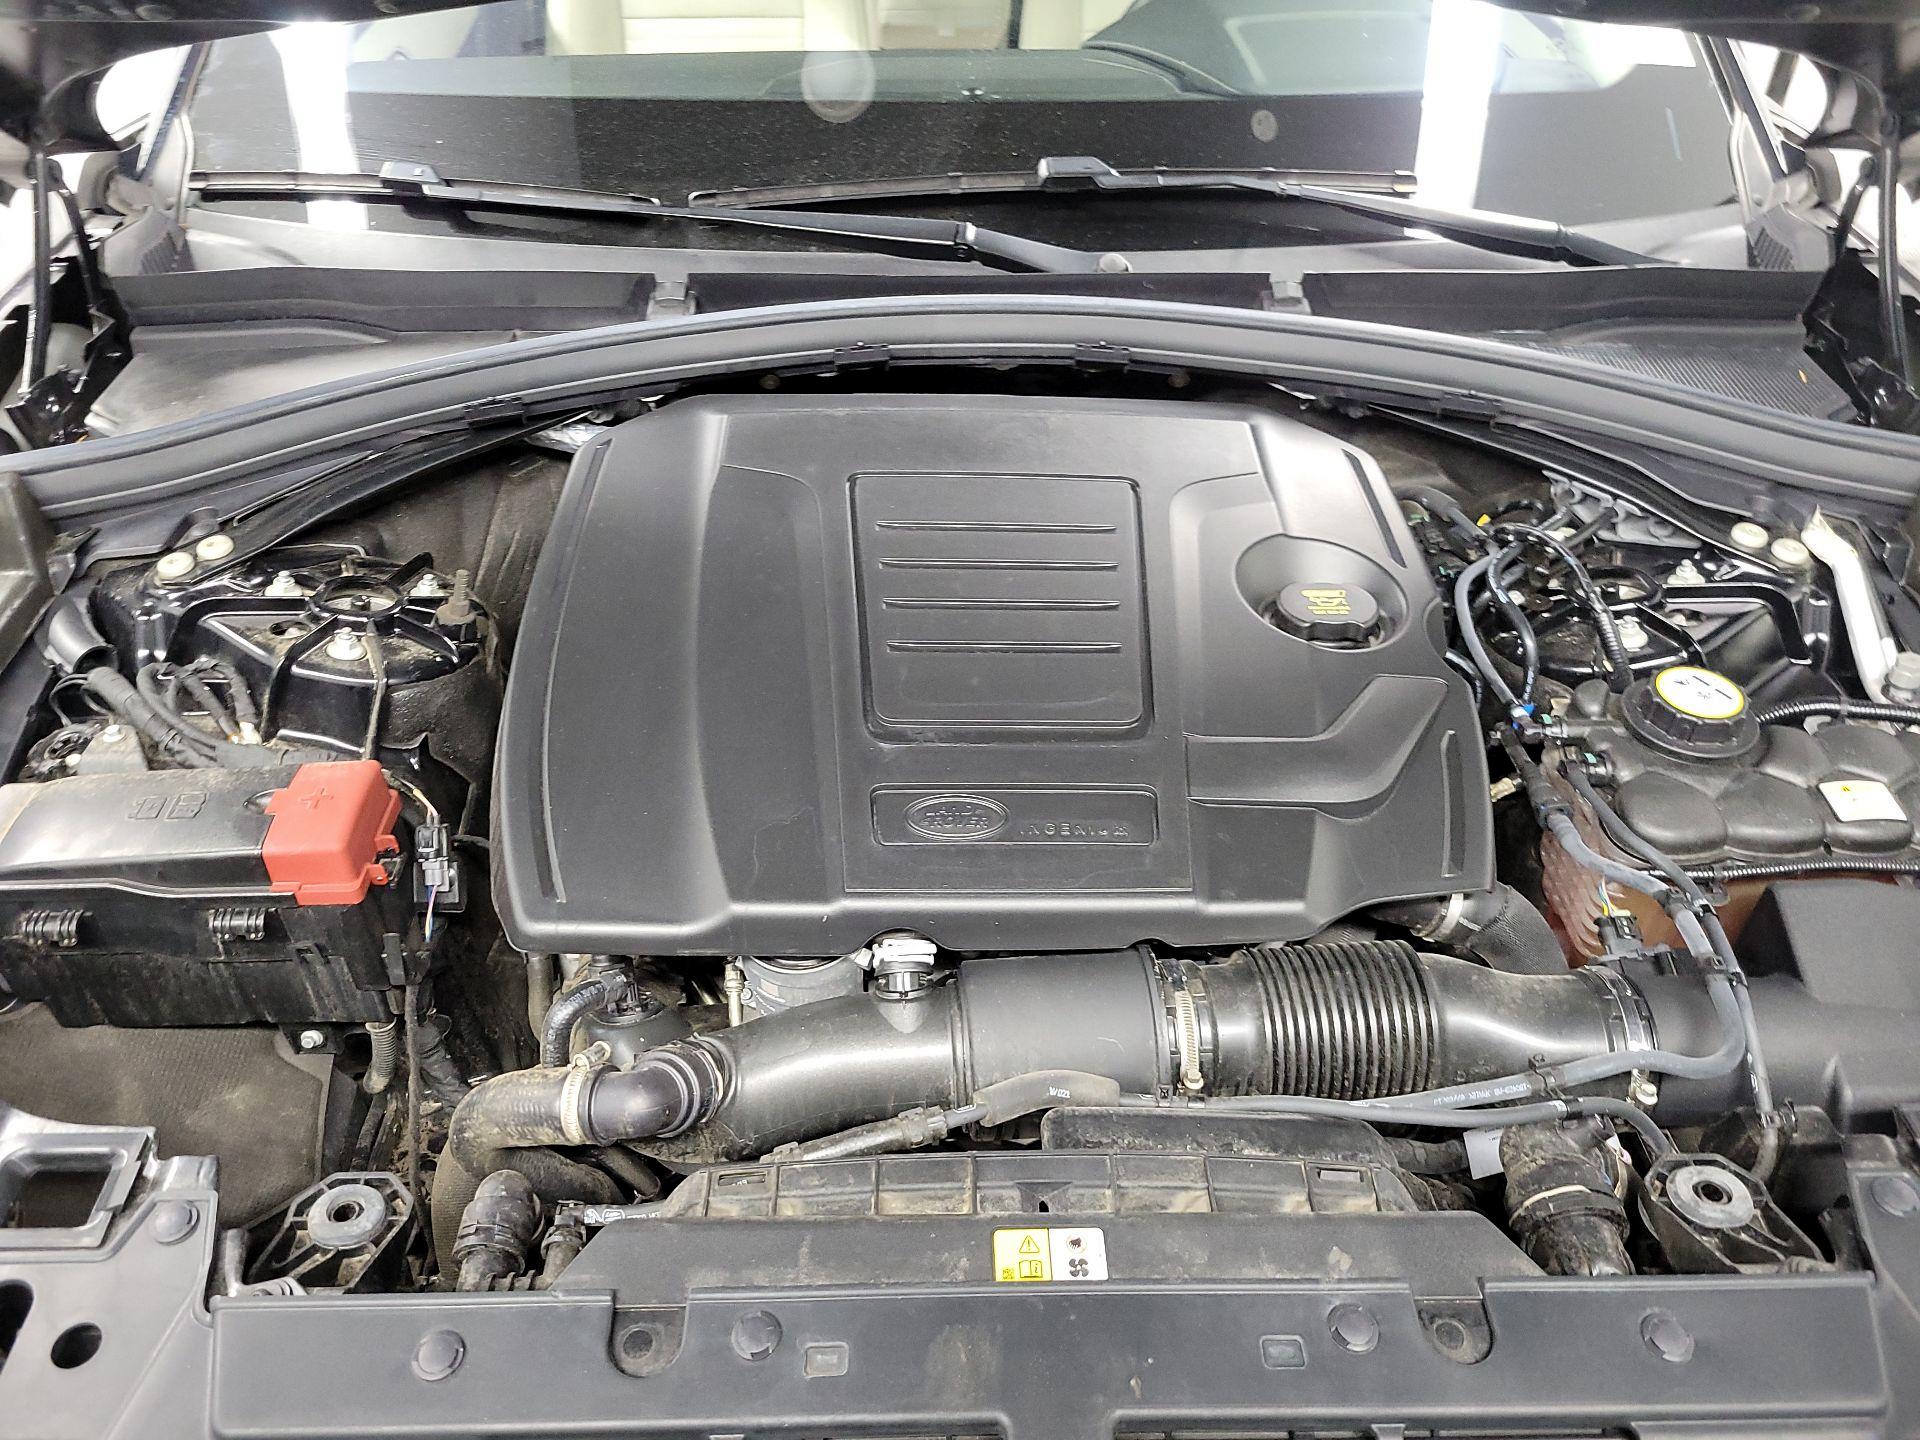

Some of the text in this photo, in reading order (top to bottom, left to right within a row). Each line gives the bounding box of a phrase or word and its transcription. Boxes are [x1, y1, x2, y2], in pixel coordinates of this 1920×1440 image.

[924, 804, 974, 816] LAND
[929, 816, 989, 829] ROVER
[1019, 822, 1129, 836] INGENIUM
